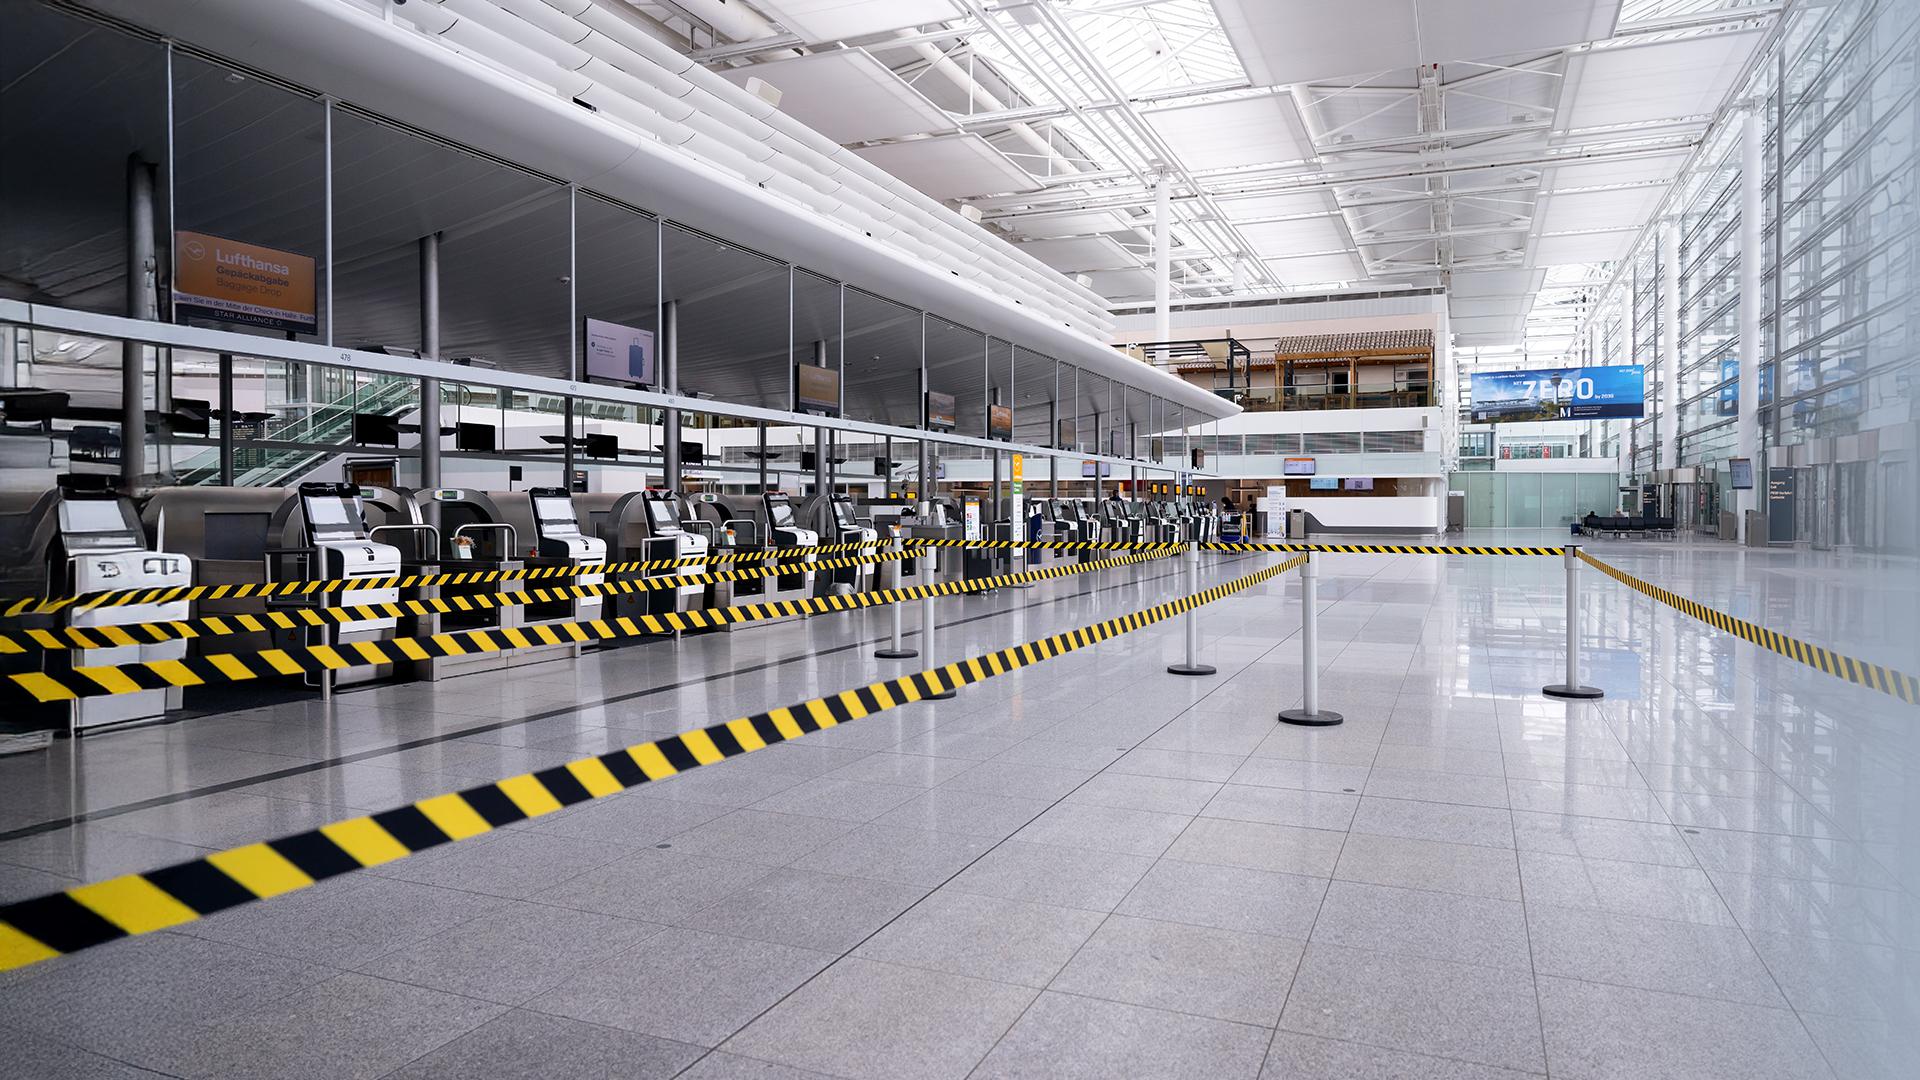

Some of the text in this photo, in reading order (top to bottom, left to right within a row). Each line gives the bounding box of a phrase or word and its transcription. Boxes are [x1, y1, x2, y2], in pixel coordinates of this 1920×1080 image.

[216, 249, 289, 276] Lufthansa
[260, 285, 282, 297] Drop
[214, 310, 274, 325] STAR ALLIANCE
[1522, 377, 1594, 400] ZERO
[1560, 407, 1571, 418] M
